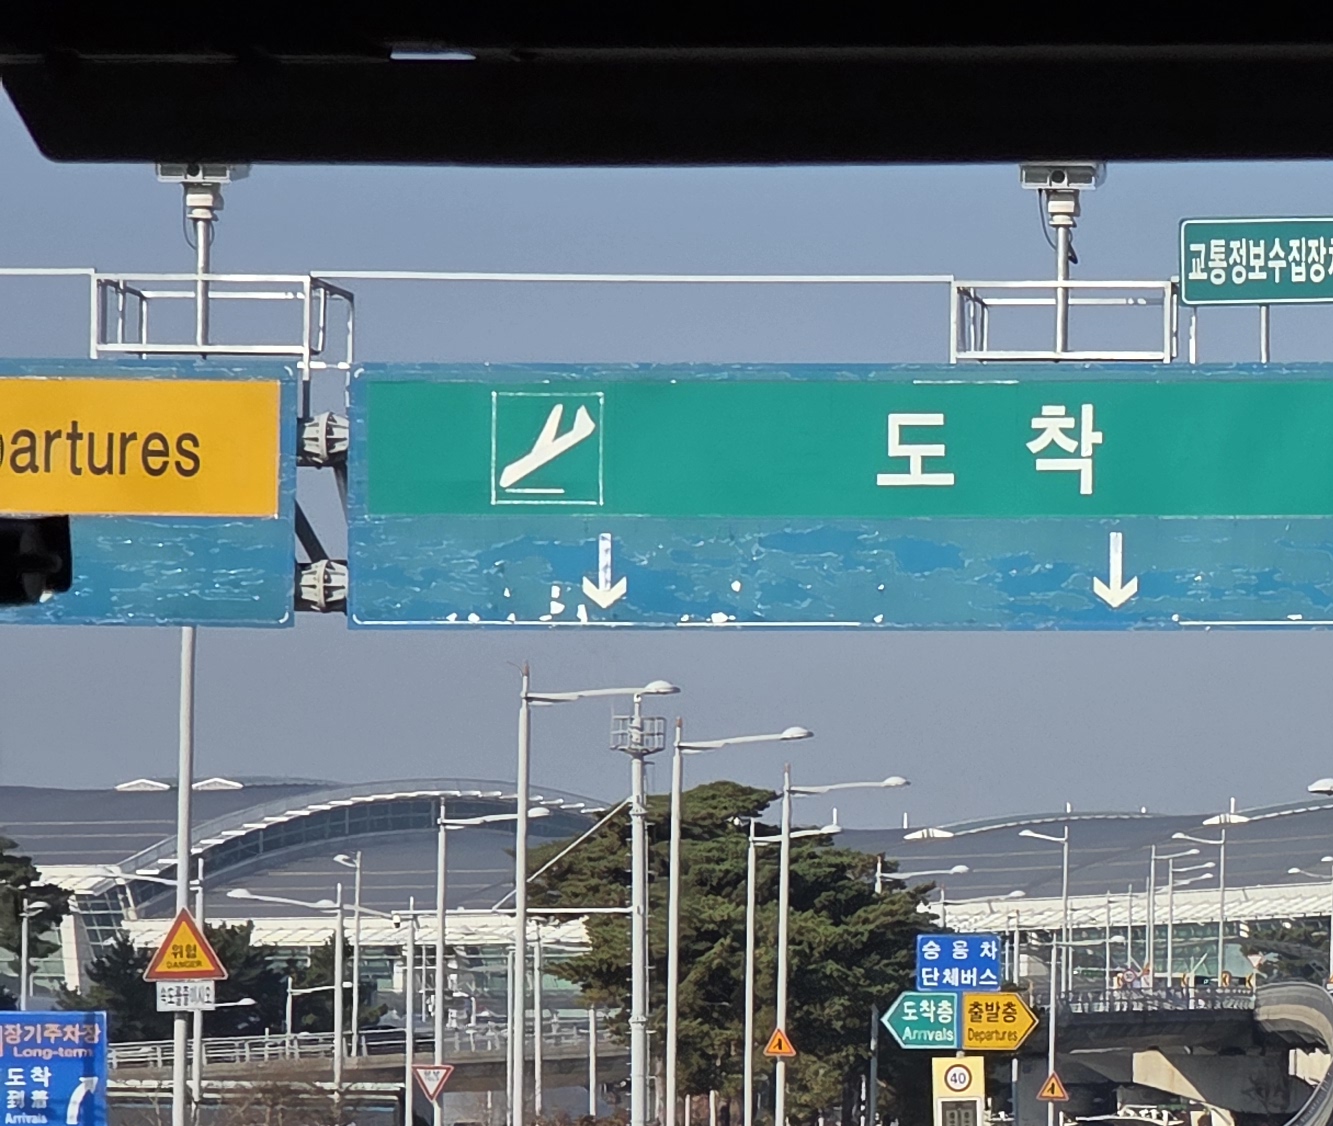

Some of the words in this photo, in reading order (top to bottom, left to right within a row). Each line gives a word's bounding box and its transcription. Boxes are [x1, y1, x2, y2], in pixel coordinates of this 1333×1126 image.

[0, 420, 200, 478] artures
[921, 967, 998, 987] 단체버스
[902, 1000, 954, 1023] 도착층
[967, 1001, 1018, 1023] 출발층
[4, 1023, 101, 1044] 장기주차장
[902, 1027, 954, 1042] Arrivals
[967, 1028, 1018, 1044] Departures
[13, 1046, 95, 1060] Long-term
[4, 1066, 52, 1087] 도착
[950, 1073, 966, 1084] 40
[5, 1112, 48, 1125] Arrivals
